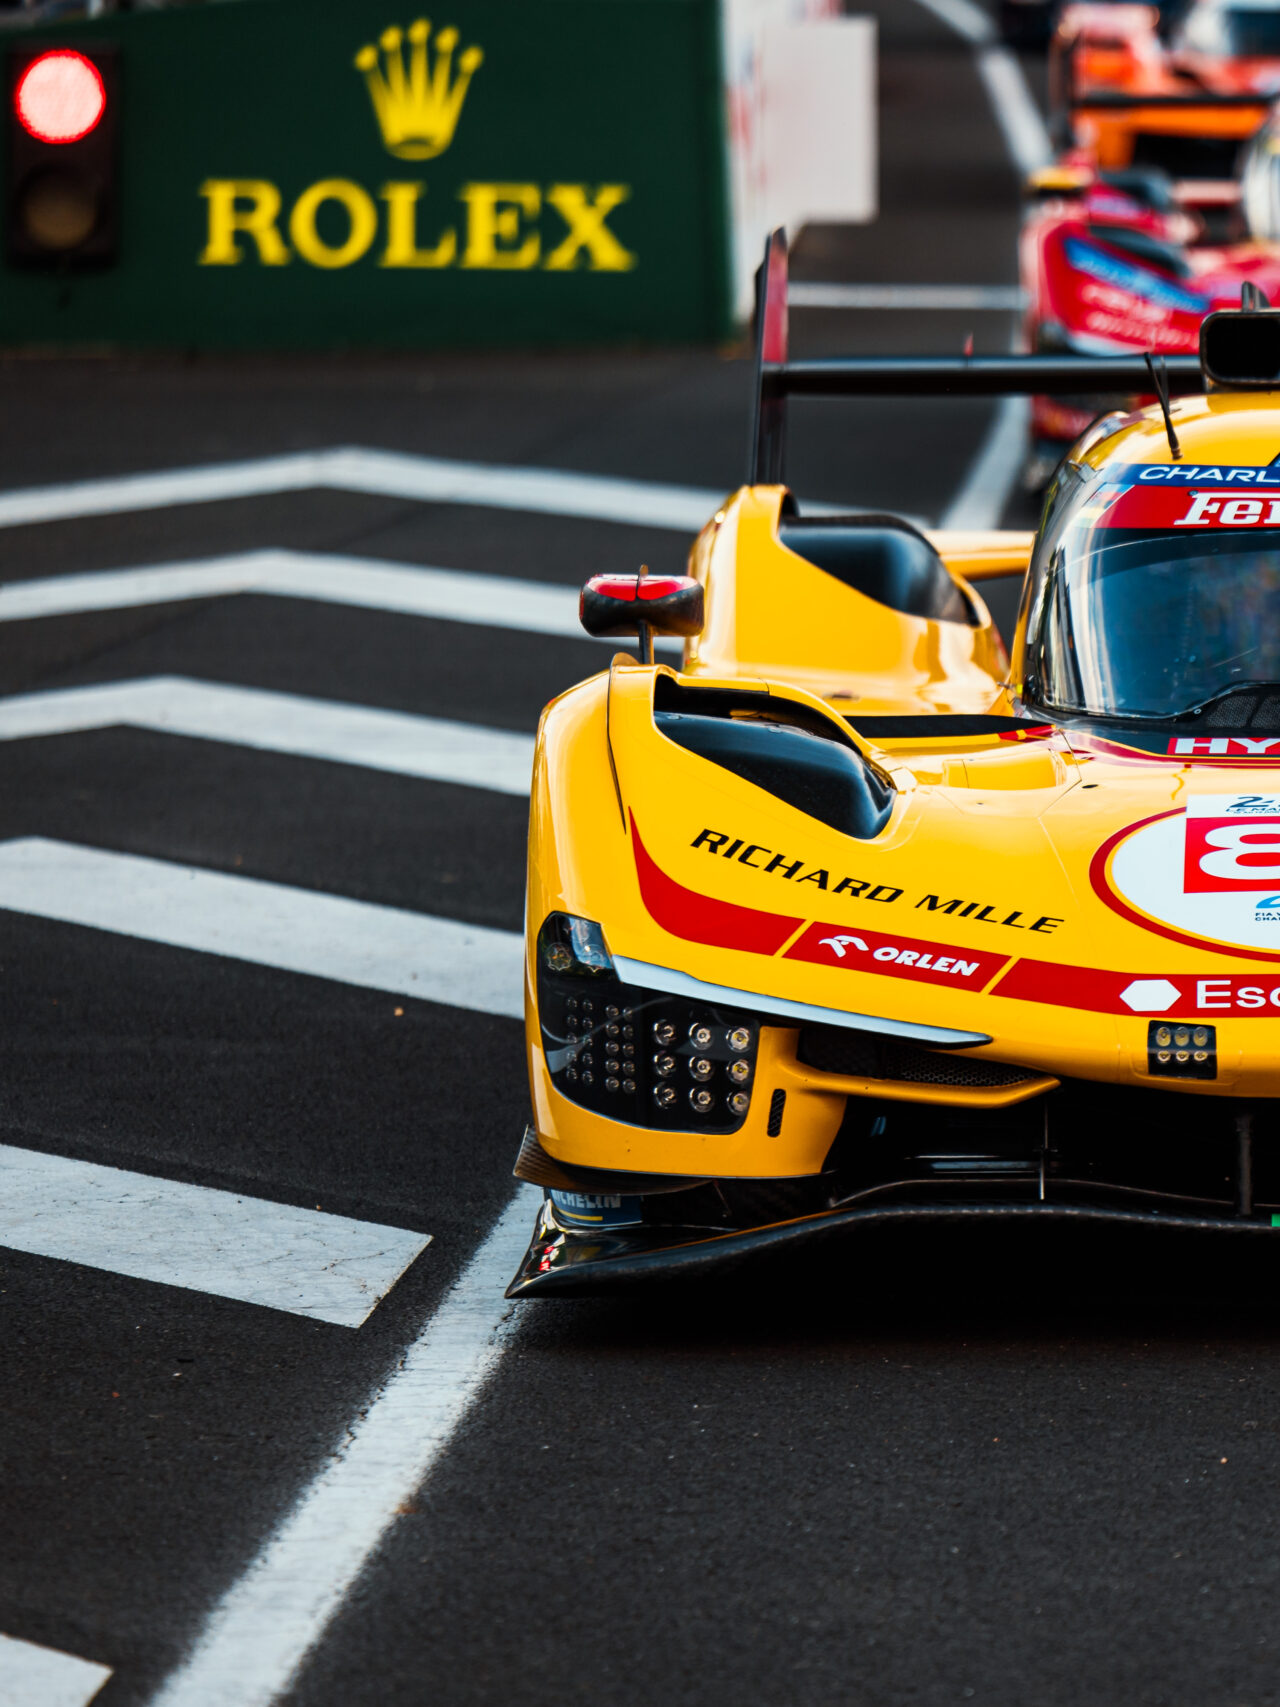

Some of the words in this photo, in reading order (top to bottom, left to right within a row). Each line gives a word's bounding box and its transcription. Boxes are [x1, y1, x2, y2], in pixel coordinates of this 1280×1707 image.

[200, 178, 635, 271] ROLEX
[690, 828, 904, 904] RICHARD
[915, 894, 1065, 934] MILLE
[873, 946, 980, 977] ORLEN
